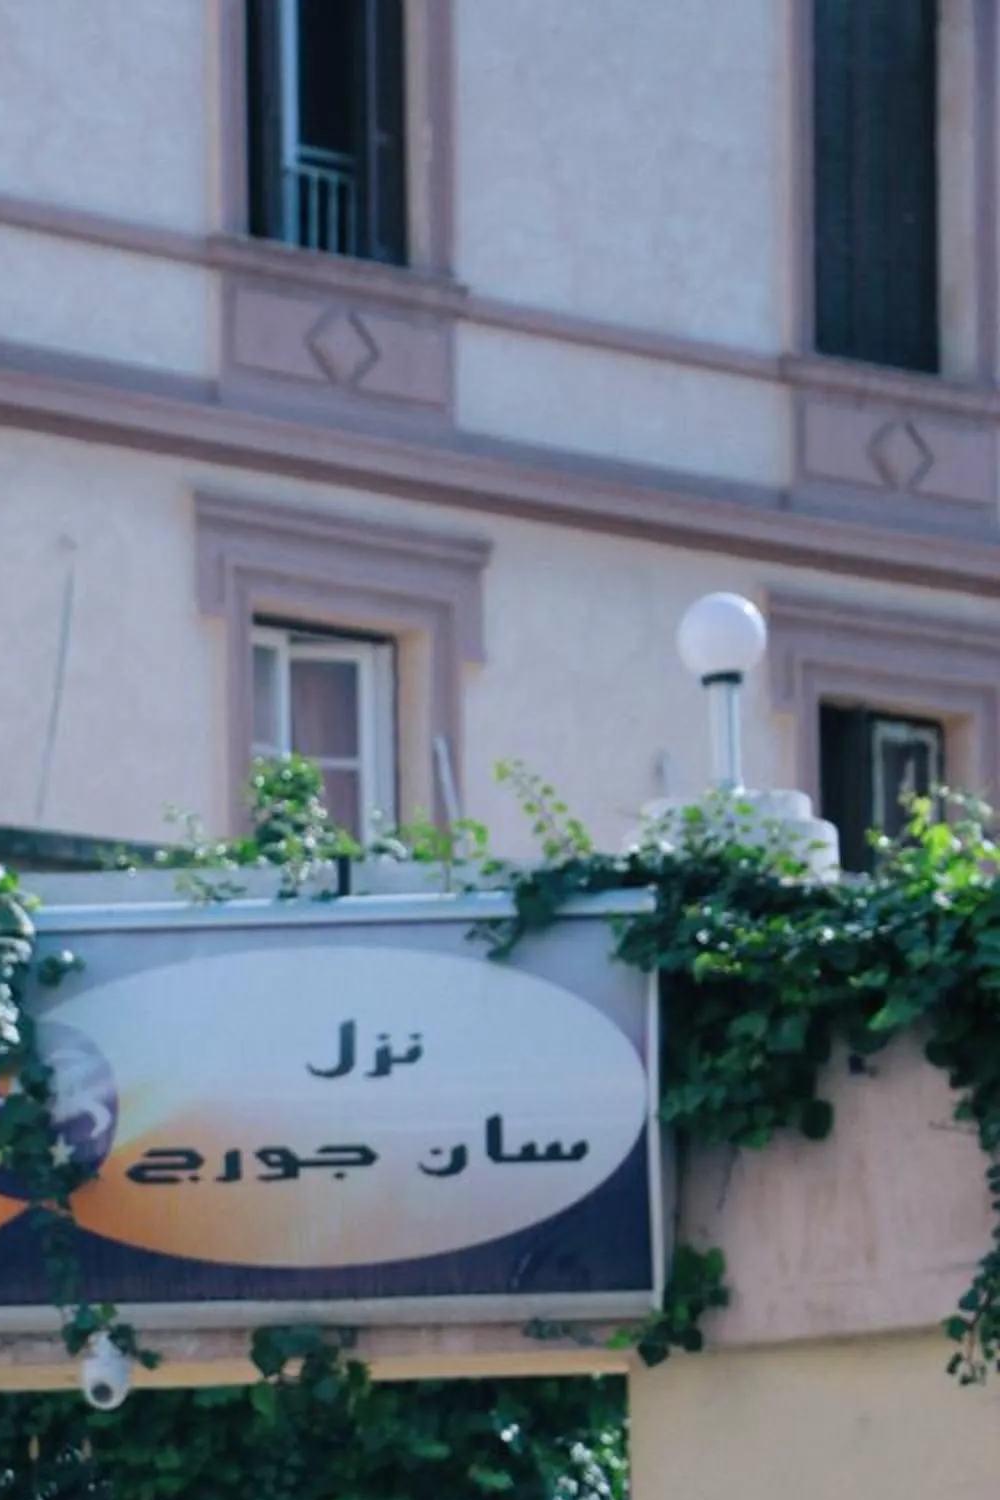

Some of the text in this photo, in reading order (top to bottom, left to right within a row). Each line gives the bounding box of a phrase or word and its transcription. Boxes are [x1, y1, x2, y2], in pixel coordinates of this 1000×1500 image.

[306, 1018, 424, 1079] نزل
[124, 1113, 589, 1184] سان جورج
